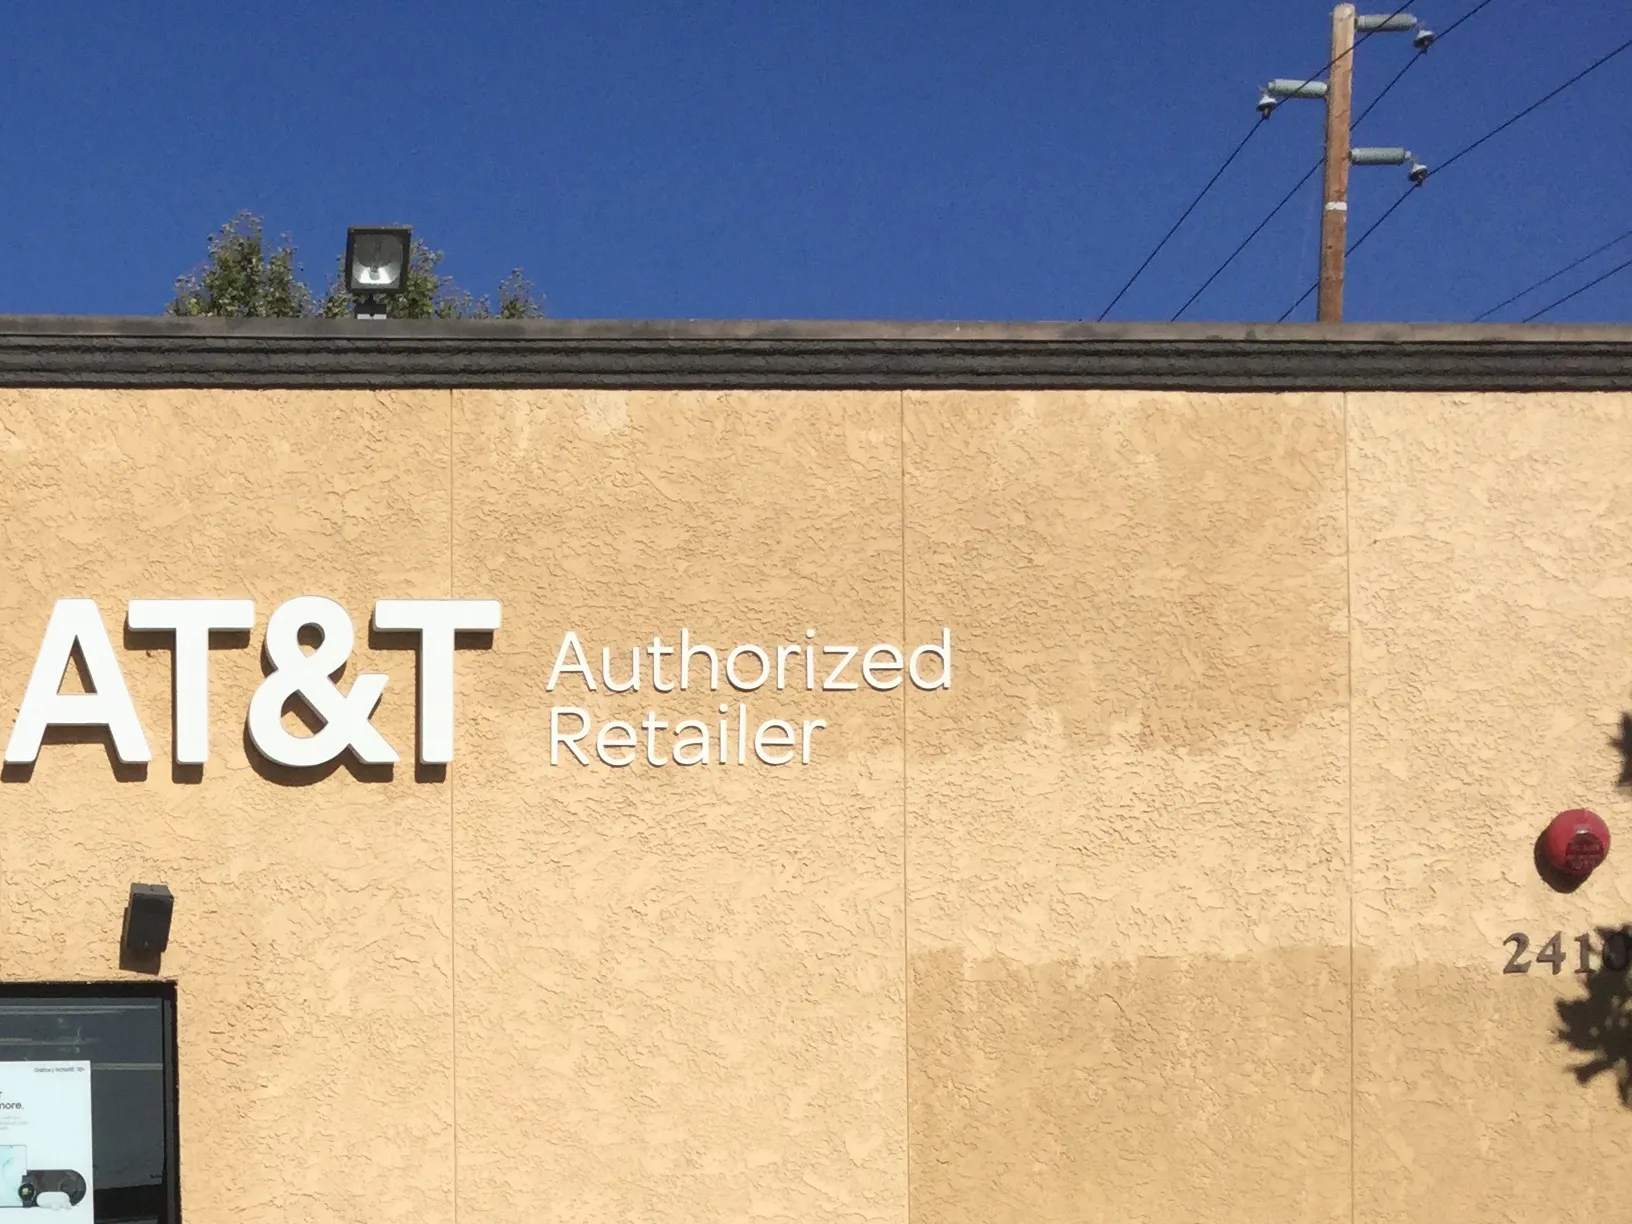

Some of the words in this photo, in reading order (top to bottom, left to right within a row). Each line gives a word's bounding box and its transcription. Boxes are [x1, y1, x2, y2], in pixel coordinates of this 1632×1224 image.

[3, 595, 502, 767] AT&T
[546, 626, 953, 694] Authorized
[547, 703, 827, 768] Retailer
